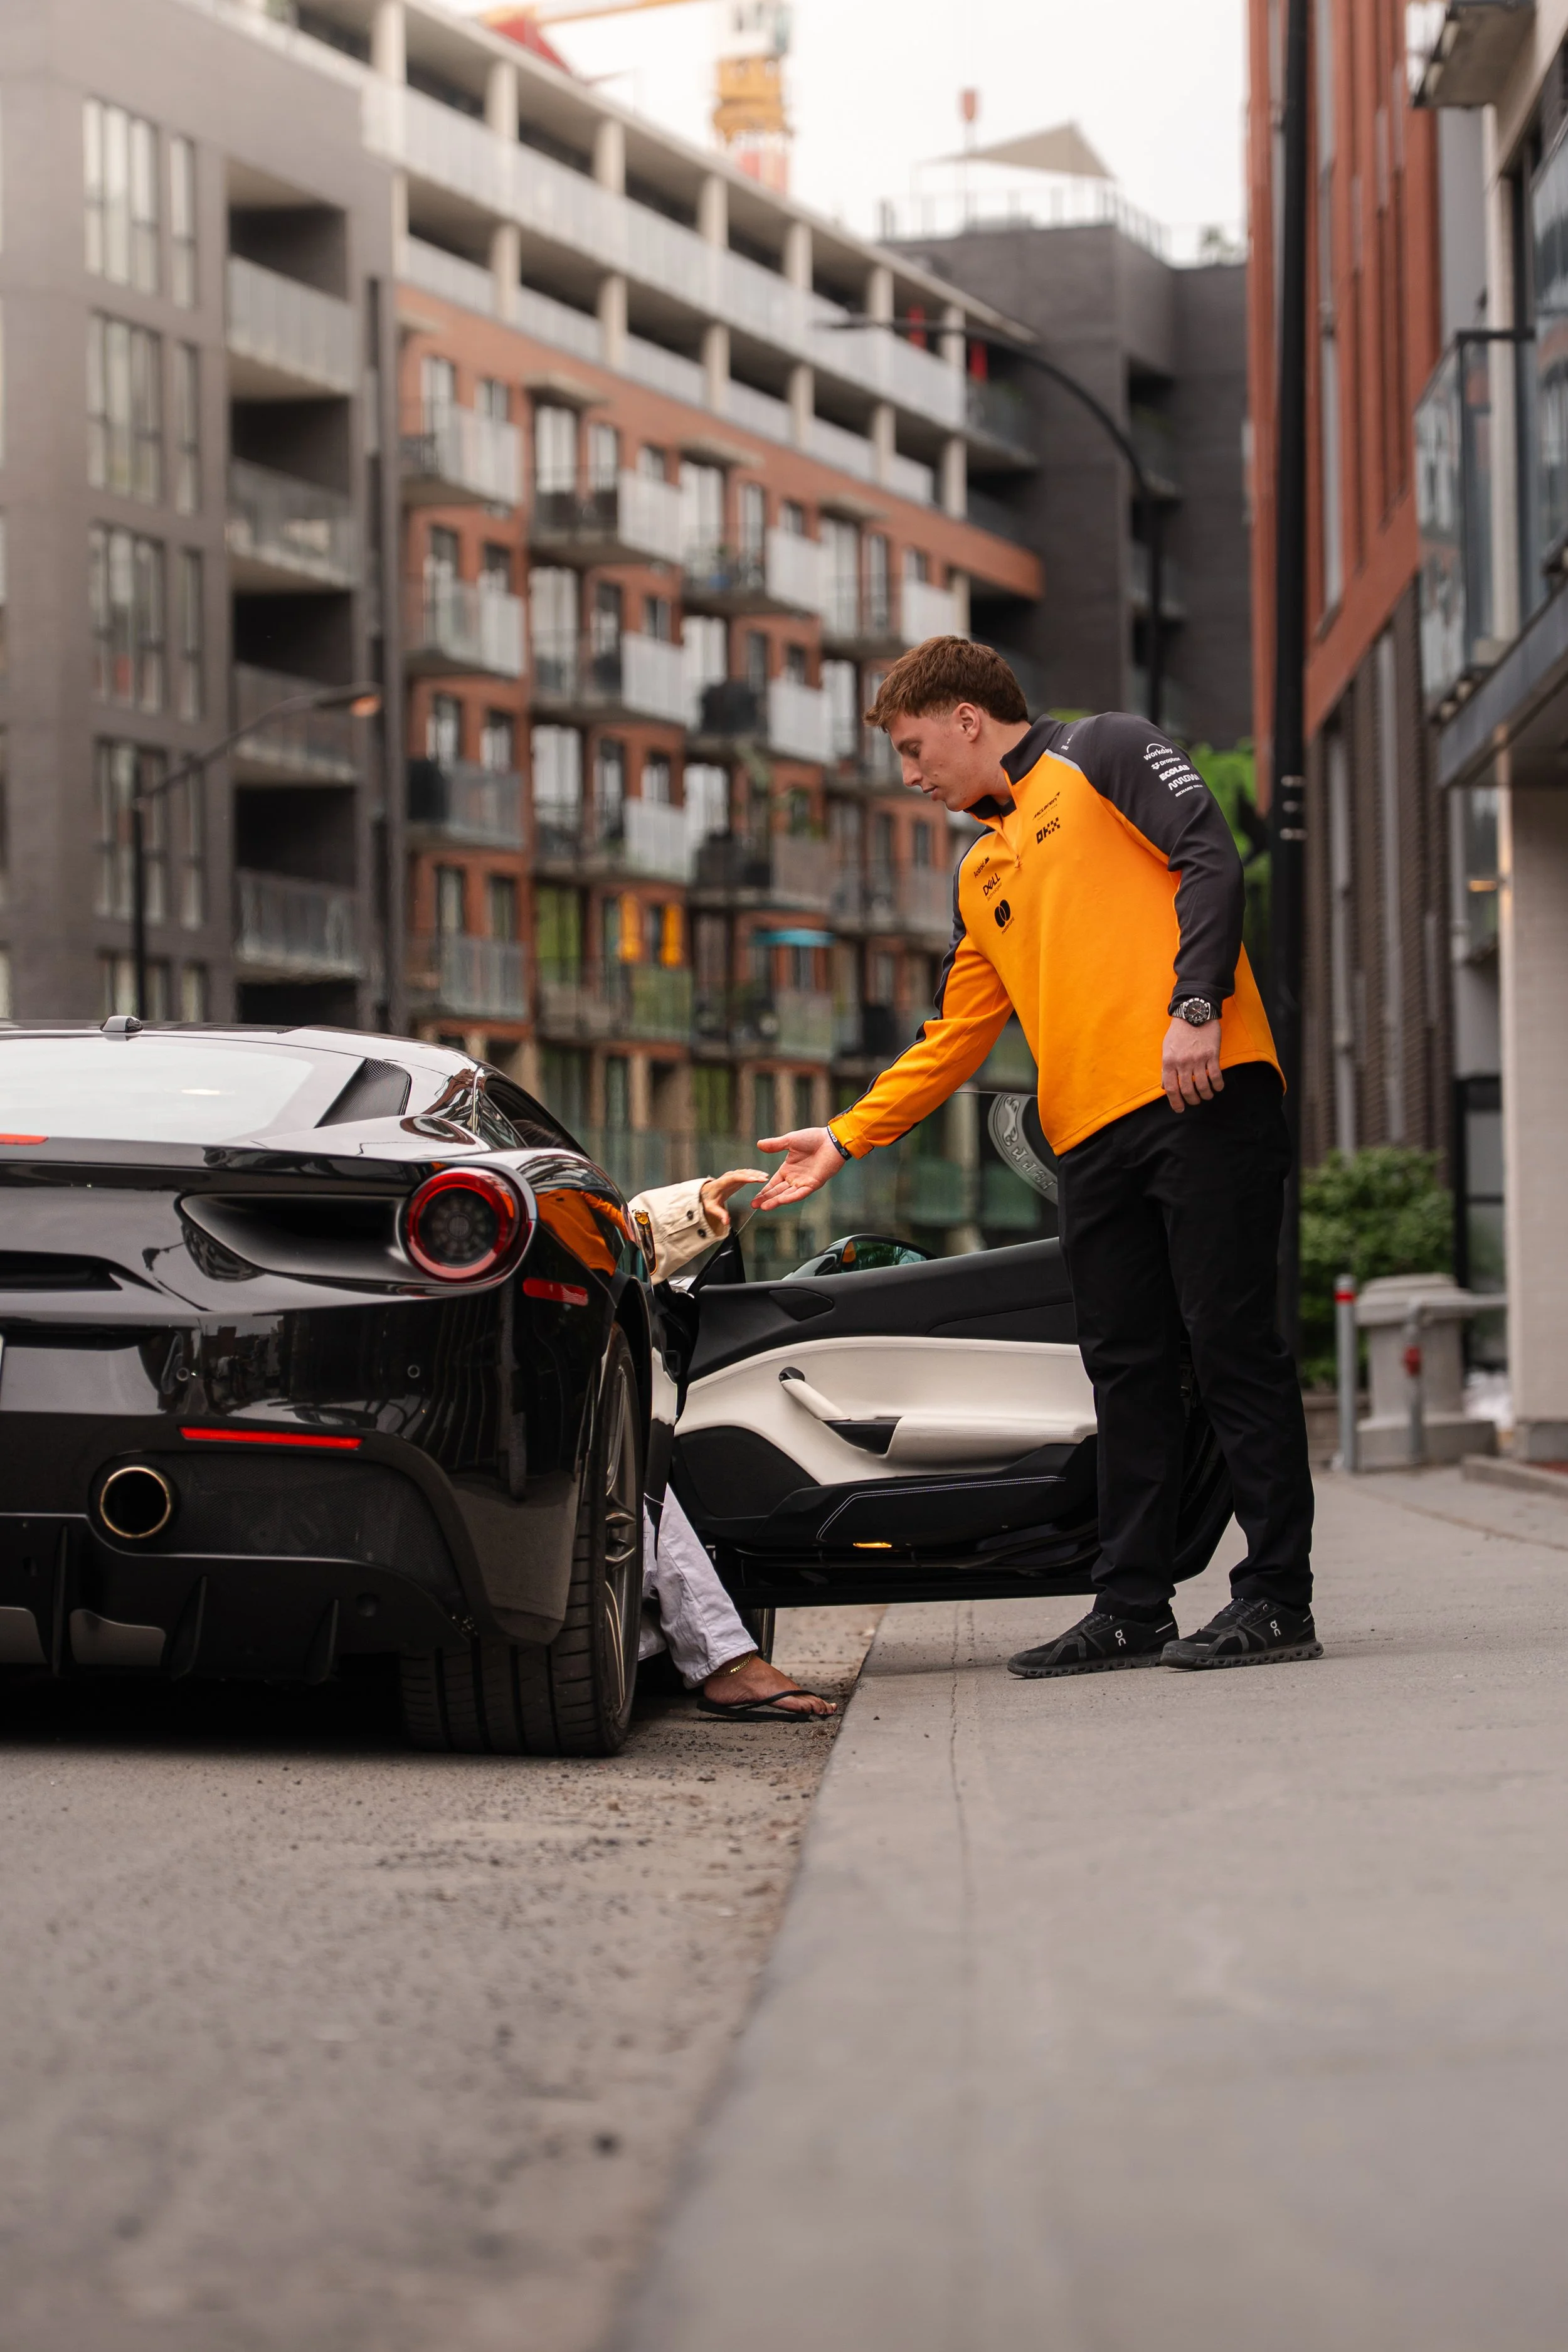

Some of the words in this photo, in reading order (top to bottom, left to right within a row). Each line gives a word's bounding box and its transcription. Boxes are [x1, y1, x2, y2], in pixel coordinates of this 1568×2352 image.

[1143, 748, 1173, 761] workday
[1158, 765, 1190, 781] ECOLAB
[1036, 817, 1061, 845] OKX
[983, 872, 1001, 897] DELL
